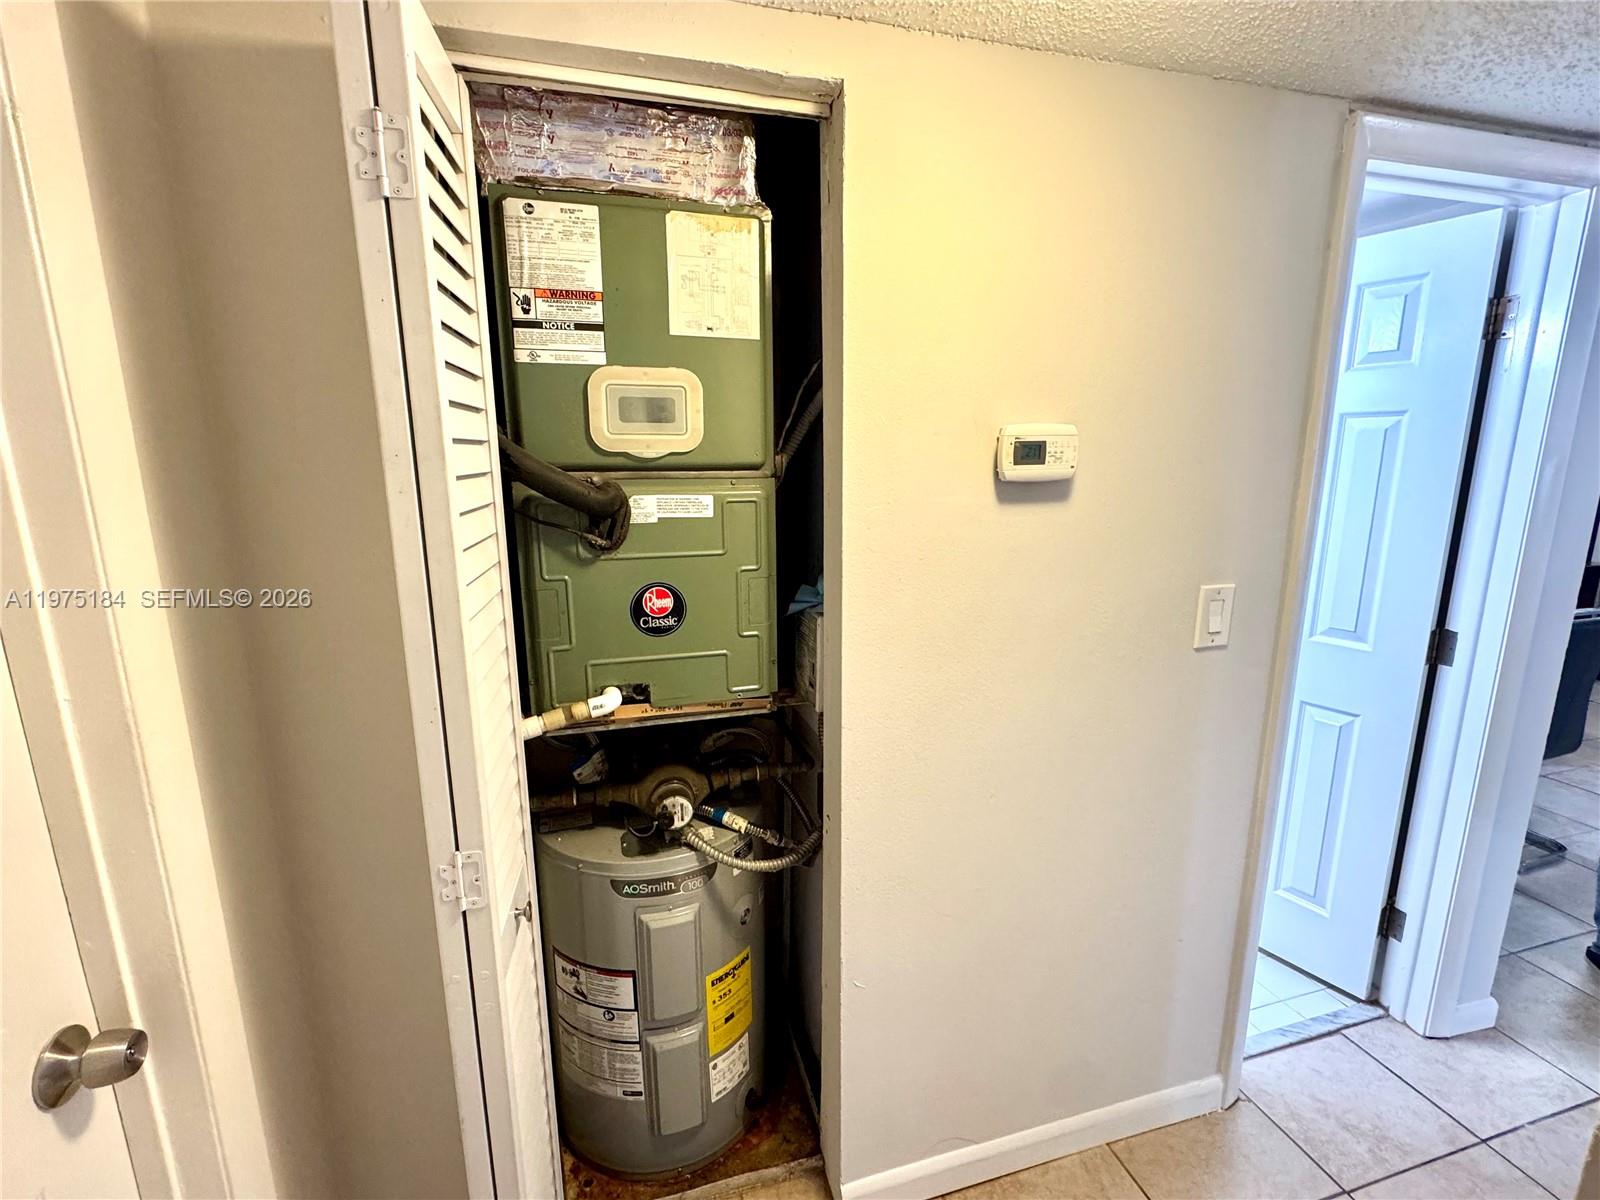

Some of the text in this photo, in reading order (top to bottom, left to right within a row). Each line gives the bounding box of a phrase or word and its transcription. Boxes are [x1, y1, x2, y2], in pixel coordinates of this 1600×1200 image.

[549, 289, 596, 300] WARNING
[542, 321, 575, 330] NOTICE
[640, 615, 678, 628] Classic
[688, 878, 704, 890] 100
